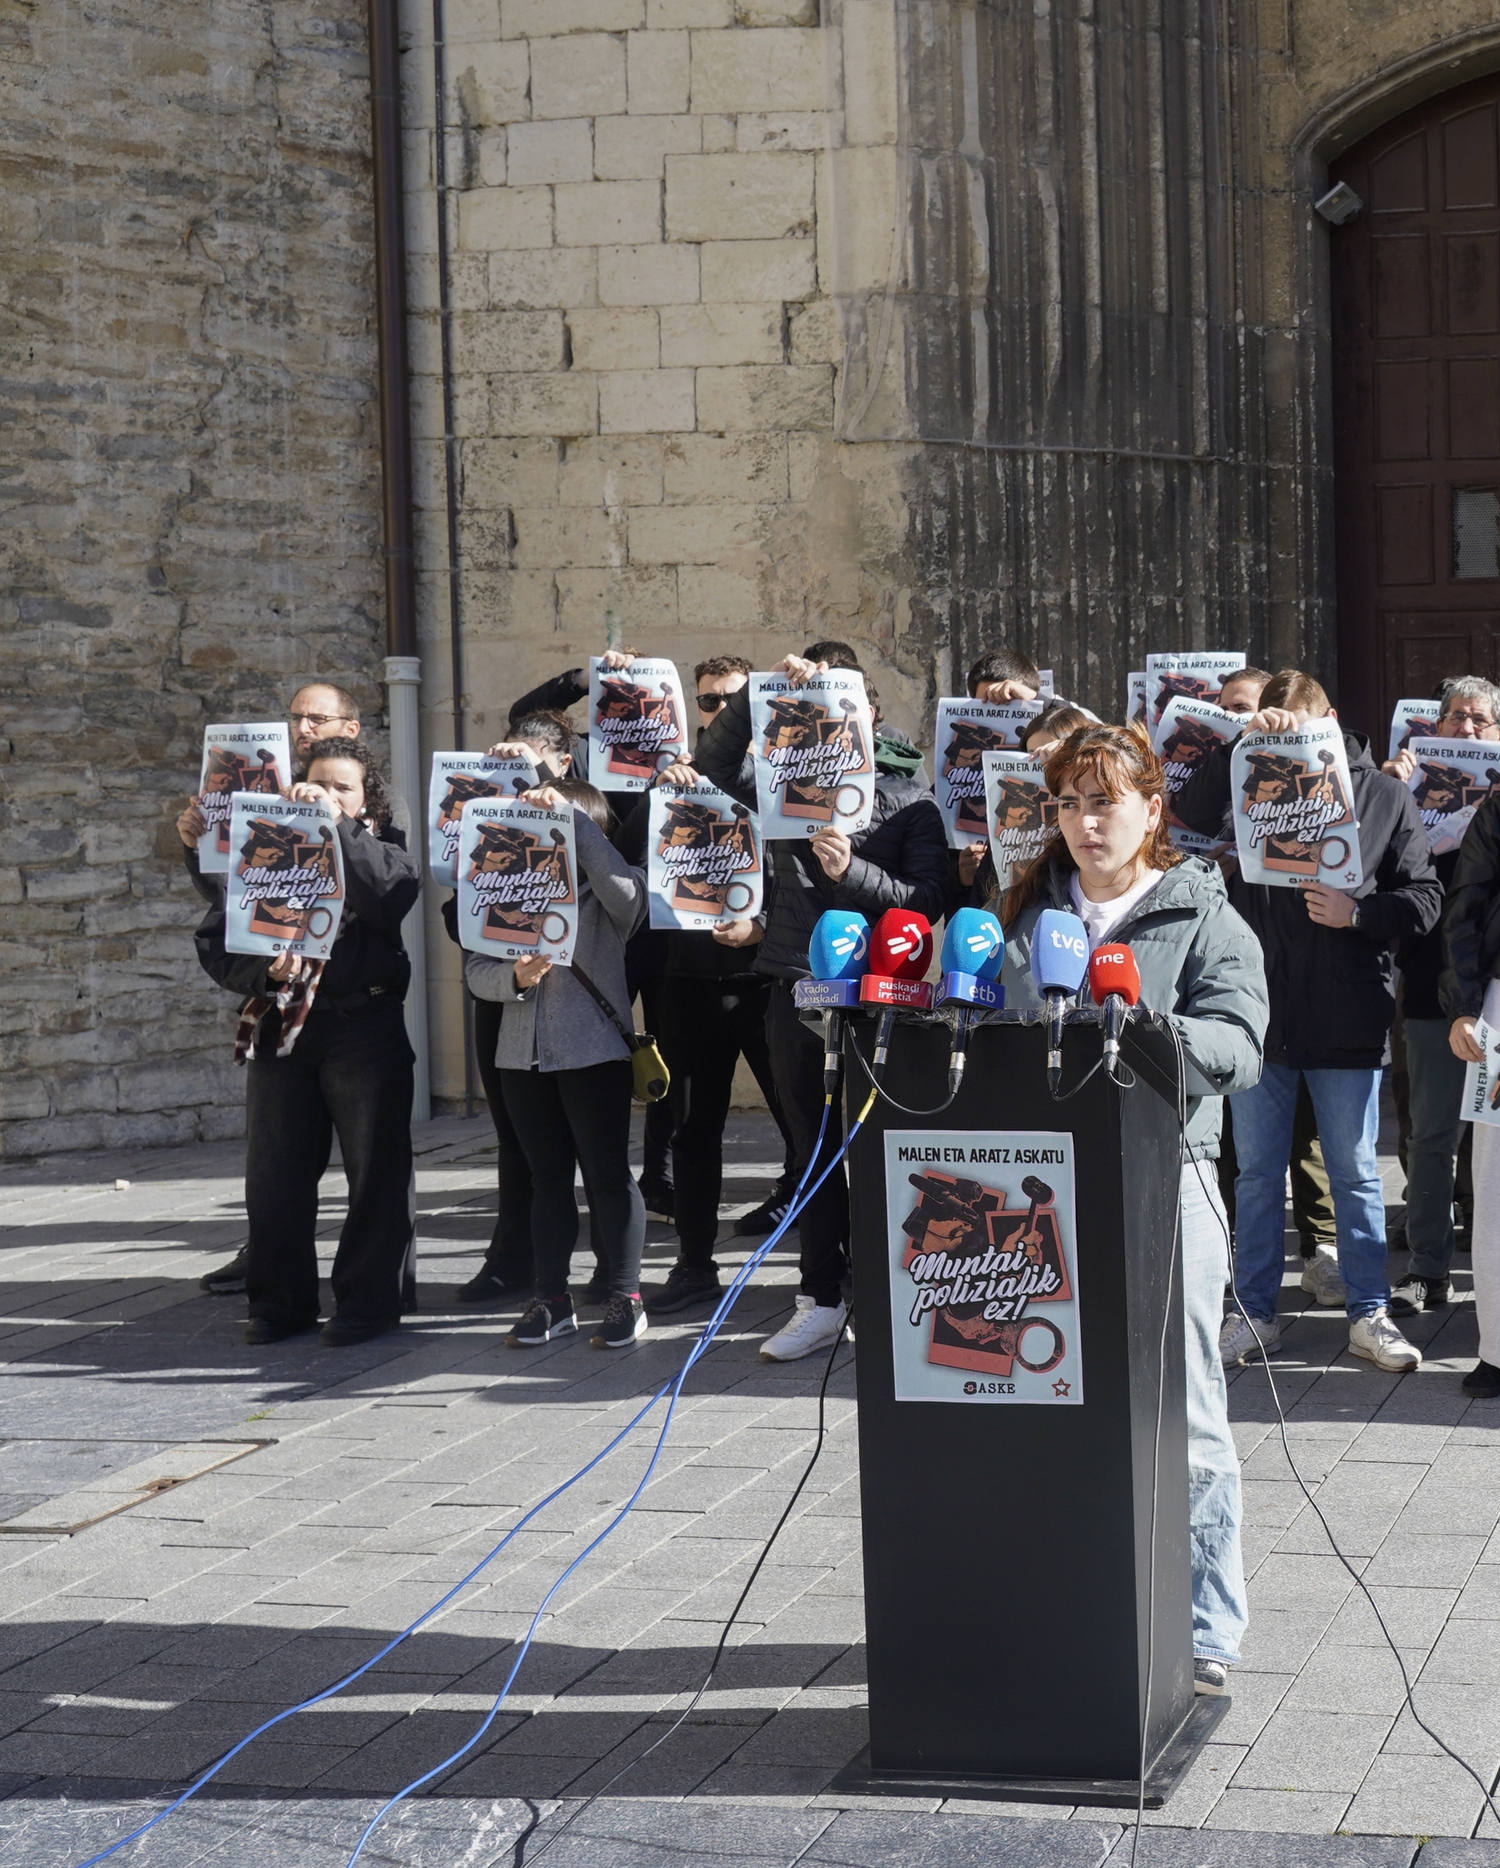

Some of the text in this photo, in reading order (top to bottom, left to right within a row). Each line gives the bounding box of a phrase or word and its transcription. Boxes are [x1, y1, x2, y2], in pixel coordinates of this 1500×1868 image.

[759, 681, 831, 692] MALEN ARATZ
[946, 707, 969, 715] MALEN
[971, 709, 984, 717] ETA
[986, 709, 1009, 718] ARATZ
[1175, 704, 1210, 716] MALEN ETA
[600, 713, 662, 732] Muntai
[229, 734, 249, 742] ARATZ
[252, 734, 282, 742] ASKATU
[599, 723, 679, 753] polizialik
[638, 739, 661, 752] ez!
[1240, 737, 1265, 750] MALEN
[1267, 736, 1282, 746] ETA
[1284, 735, 1309, 745] ARATZ
[769, 737, 843, 766] Muntai
[1415, 747, 1440, 757] MALEN
[1441, 750, 1454, 758] ETA
[1457, 750, 1481, 760] ARATZ
[442, 762, 465, 770] MALEN
[467, 762, 481, 770] ETA
[509, 763, 534, 771] ASKA
[770, 751, 864, 792] polizialik
[992, 763, 1015, 772] MALEN
[1016, 763, 1029, 772] ETA
[816, 771, 843, 787] ez!
[686, 787, 699, 795] ETA
[242, 804, 268, 814] MALEN
[270, 806, 283, 815] ETA
[286, 807, 312, 817] ARATZ
[1248, 791, 1324, 821] Muntai
[472, 808, 570, 823] MALEN ETA ARATZ ASKATU
[1250, 803, 1345, 847] polizialik
[1297, 824, 1324, 842] ez!
[662, 840, 733, 862] Muntai
[242, 863, 319, 884] Muntai
[661, 851, 753, 887] polizialik
[473, 866, 552, 889] Muntai
[706, 870, 733, 884] ez!
[240, 876, 337, 909] polizialik
[472, 880, 569, 915] polizialik
[287, 894, 317, 909] ez!
[521, 898, 549, 913] ez!
[1051, 930, 1085, 958] tve
[1096, 953, 1124, 965] rne
[804, 984, 829, 994] radio
[879, 981, 920, 994] euskadi
[969, 985, 996, 1003] etb
[804, 994, 839, 1003] euskadi
[878, 989, 911, 1002] irratia
[1478, 1072, 1487, 1085] ETA
[1473, 1085, 1486, 1113] MALEN
[899, 1147, 1064, 1163] MALEN ETA ARATZ ASKATU
[910, 1242, 1028, 1281] Muntai
[911, 1263, 1061, 1323] polizialik
[984, 1295, 1028, 1320] ez!
[978, 1383, 1015, 1394] ASKE
